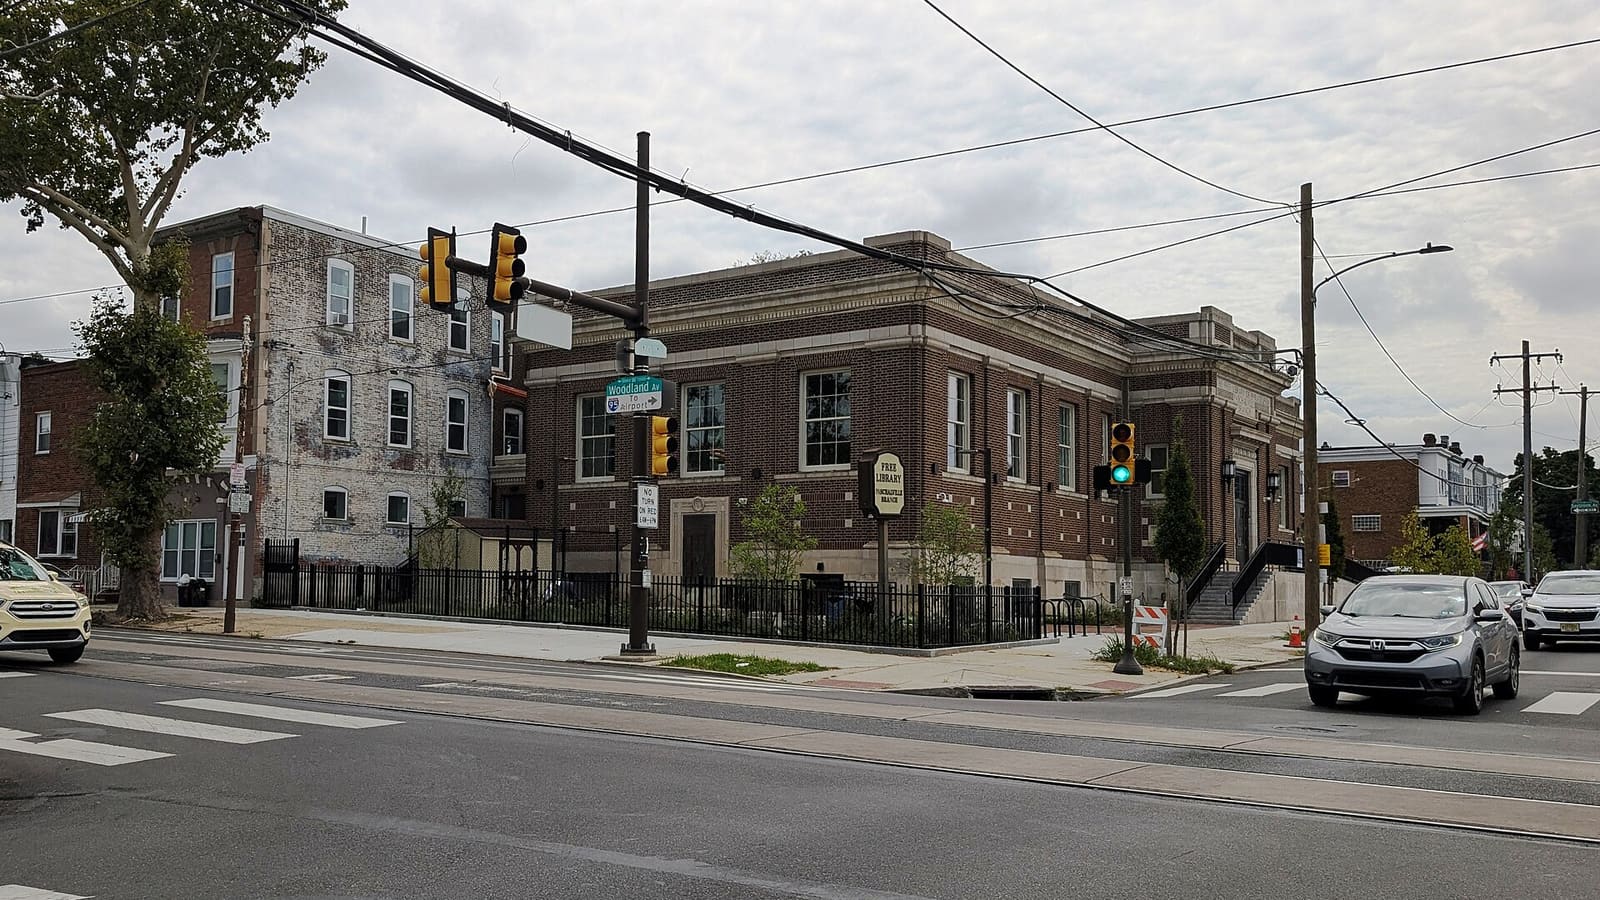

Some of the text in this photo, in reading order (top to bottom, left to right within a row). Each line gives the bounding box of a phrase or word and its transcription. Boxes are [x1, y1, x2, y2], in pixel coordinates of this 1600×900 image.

[608, 381, 649, 395] Woodland
[608, 401, 619, 409] 95
[620, 402, 648, 410] Airport
[881, 462, 897, 472] FREE
[876, 473, 902, 483] LIBRARY
[643, 488, 652, 496] NO
[641, 497, 655, 505] TURN
[639, 506, 657, 515] ON RED
